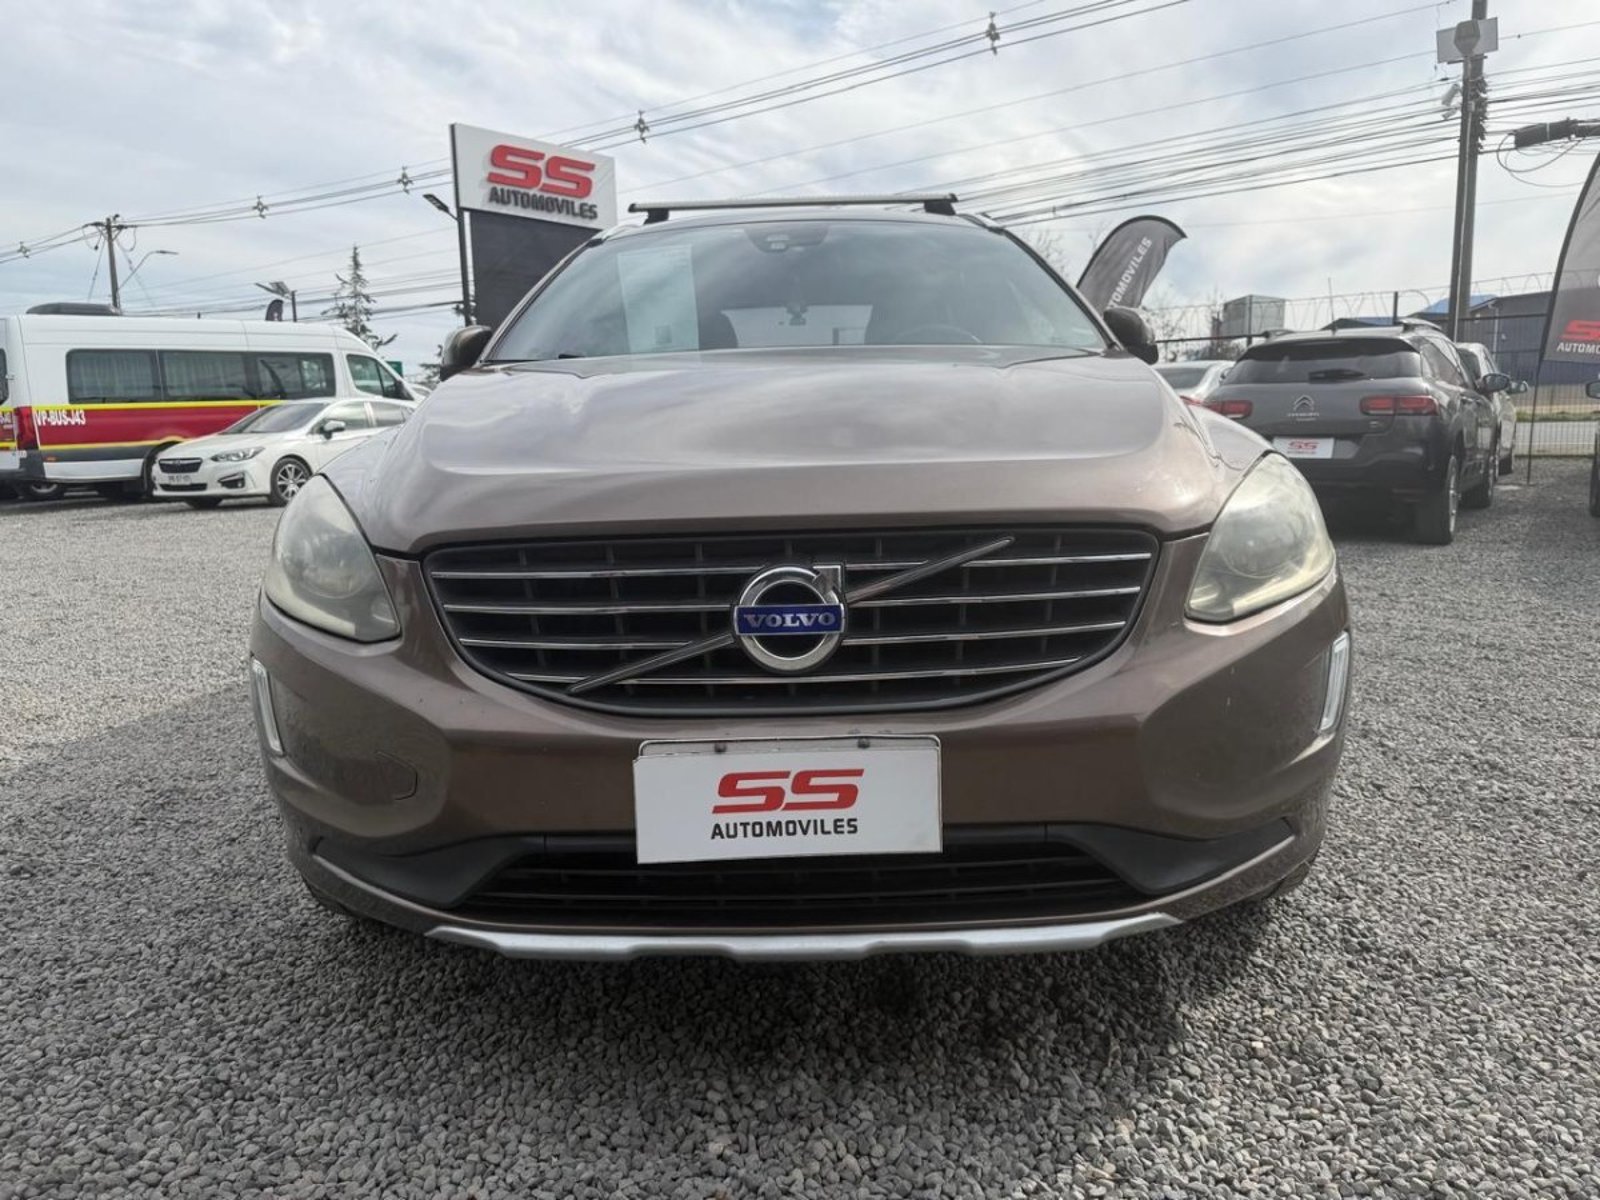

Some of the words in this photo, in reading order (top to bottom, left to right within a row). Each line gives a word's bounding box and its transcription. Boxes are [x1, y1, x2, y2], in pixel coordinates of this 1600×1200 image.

[487, 144, 596, 199] SS
[488, 186, 598, 220] AUTOMOVILES
[743, 611, 836, 628] VOLVO
[712, 768, 865, 814] SS
[710, 817, 859, 840] AUTOMOVILES
